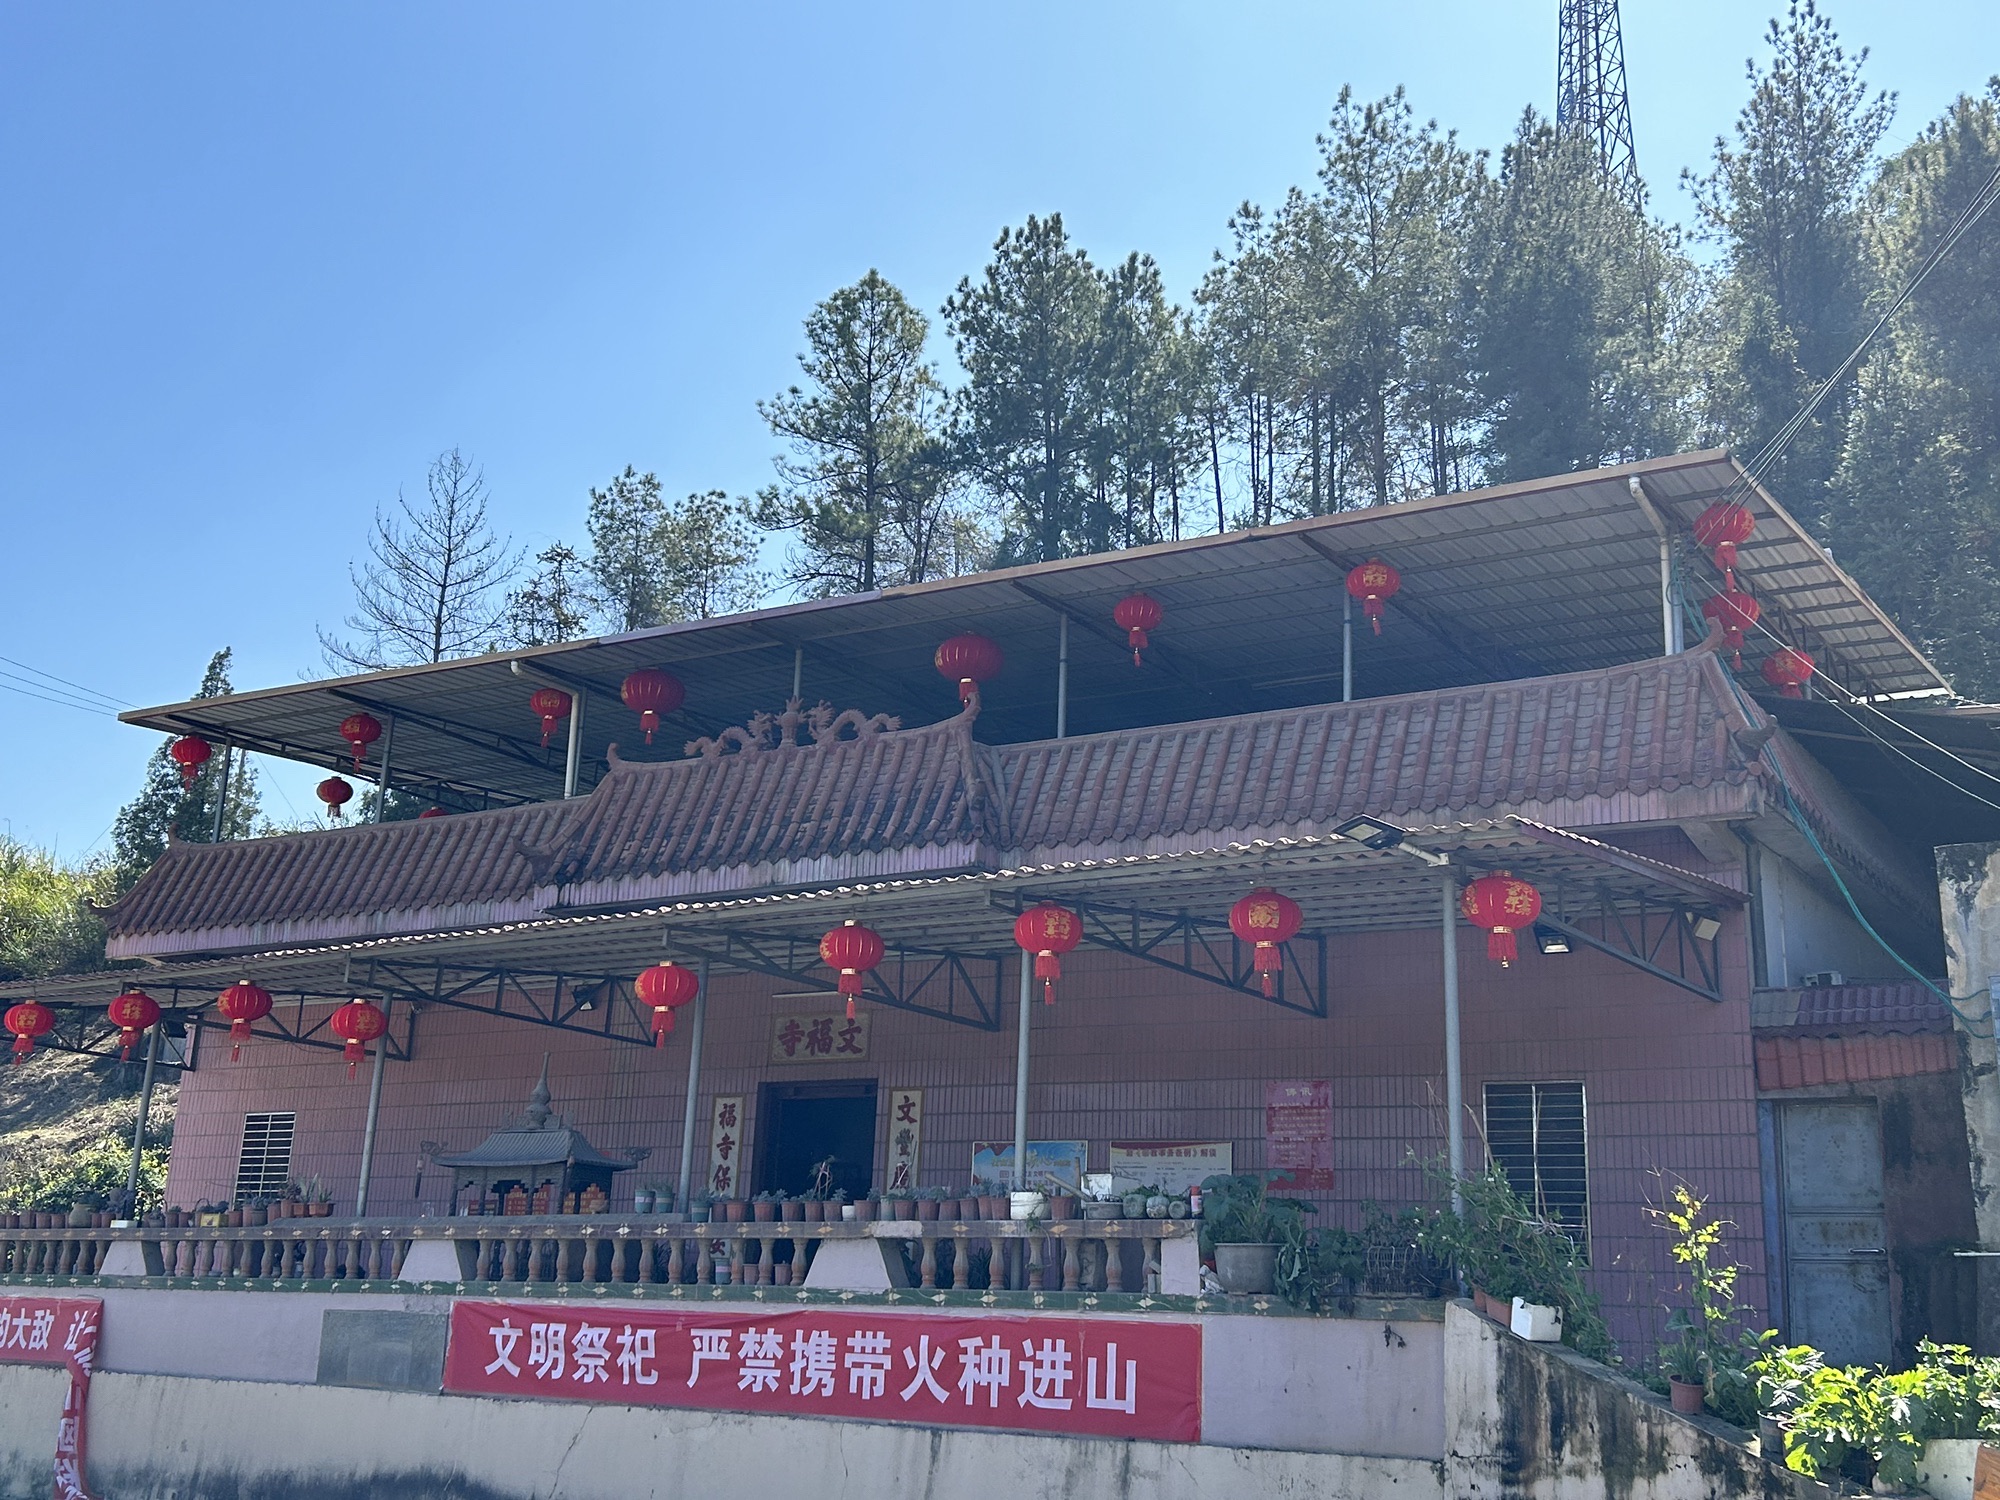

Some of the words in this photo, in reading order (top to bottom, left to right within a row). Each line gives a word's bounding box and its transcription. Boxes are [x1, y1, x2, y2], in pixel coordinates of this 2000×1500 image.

[777, 1018, 863, 1057] 文福寺
[484, 1317, 658, 1386] 文明祭祀
[687, 1326, 1138, 1415] 严禁携带火种进山
